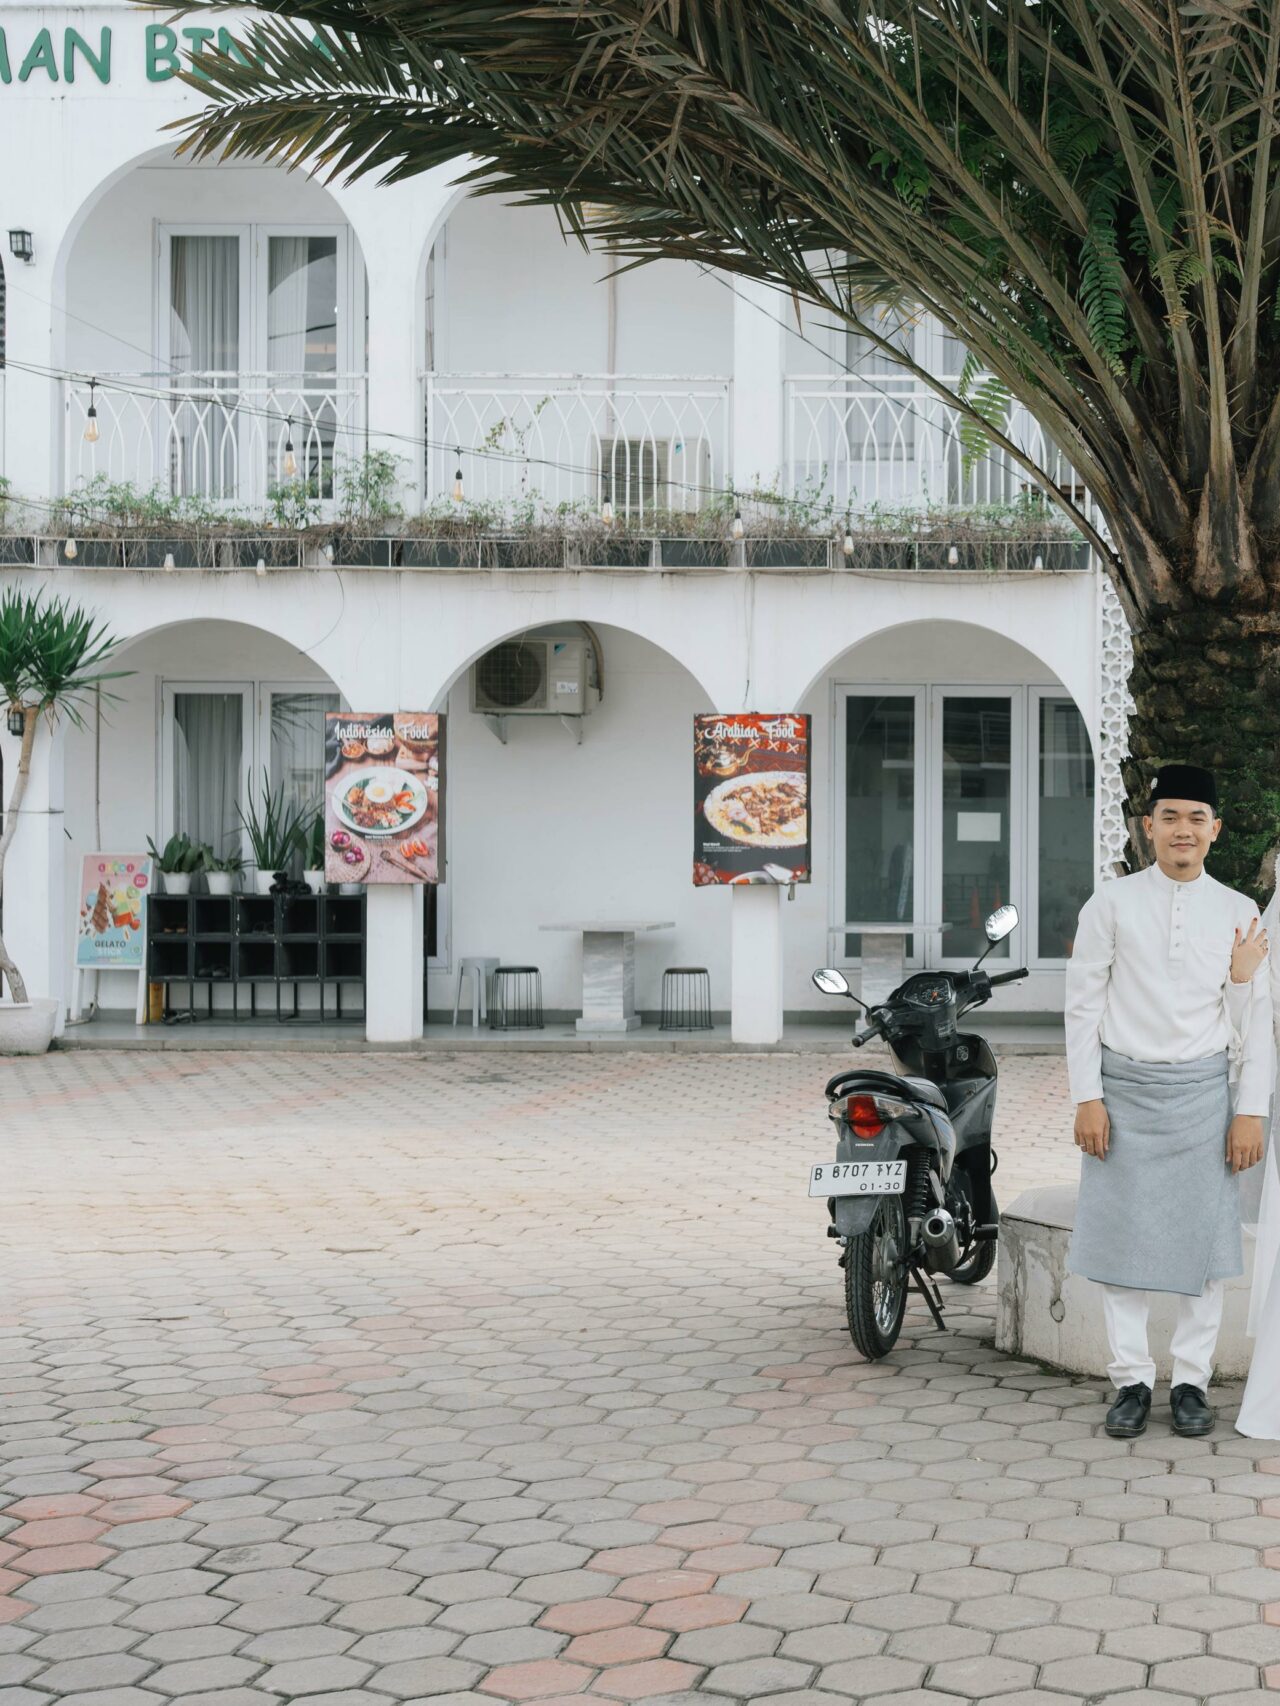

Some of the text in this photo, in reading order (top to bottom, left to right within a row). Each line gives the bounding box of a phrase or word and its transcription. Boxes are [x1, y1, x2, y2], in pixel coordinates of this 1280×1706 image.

[334, 719, 430, 740] Indonesian Food
[704, 719, 797, 740] Arabian Food
[95, 940, 127, 948] GELATO
[815, 1168, 823, 1180] B
